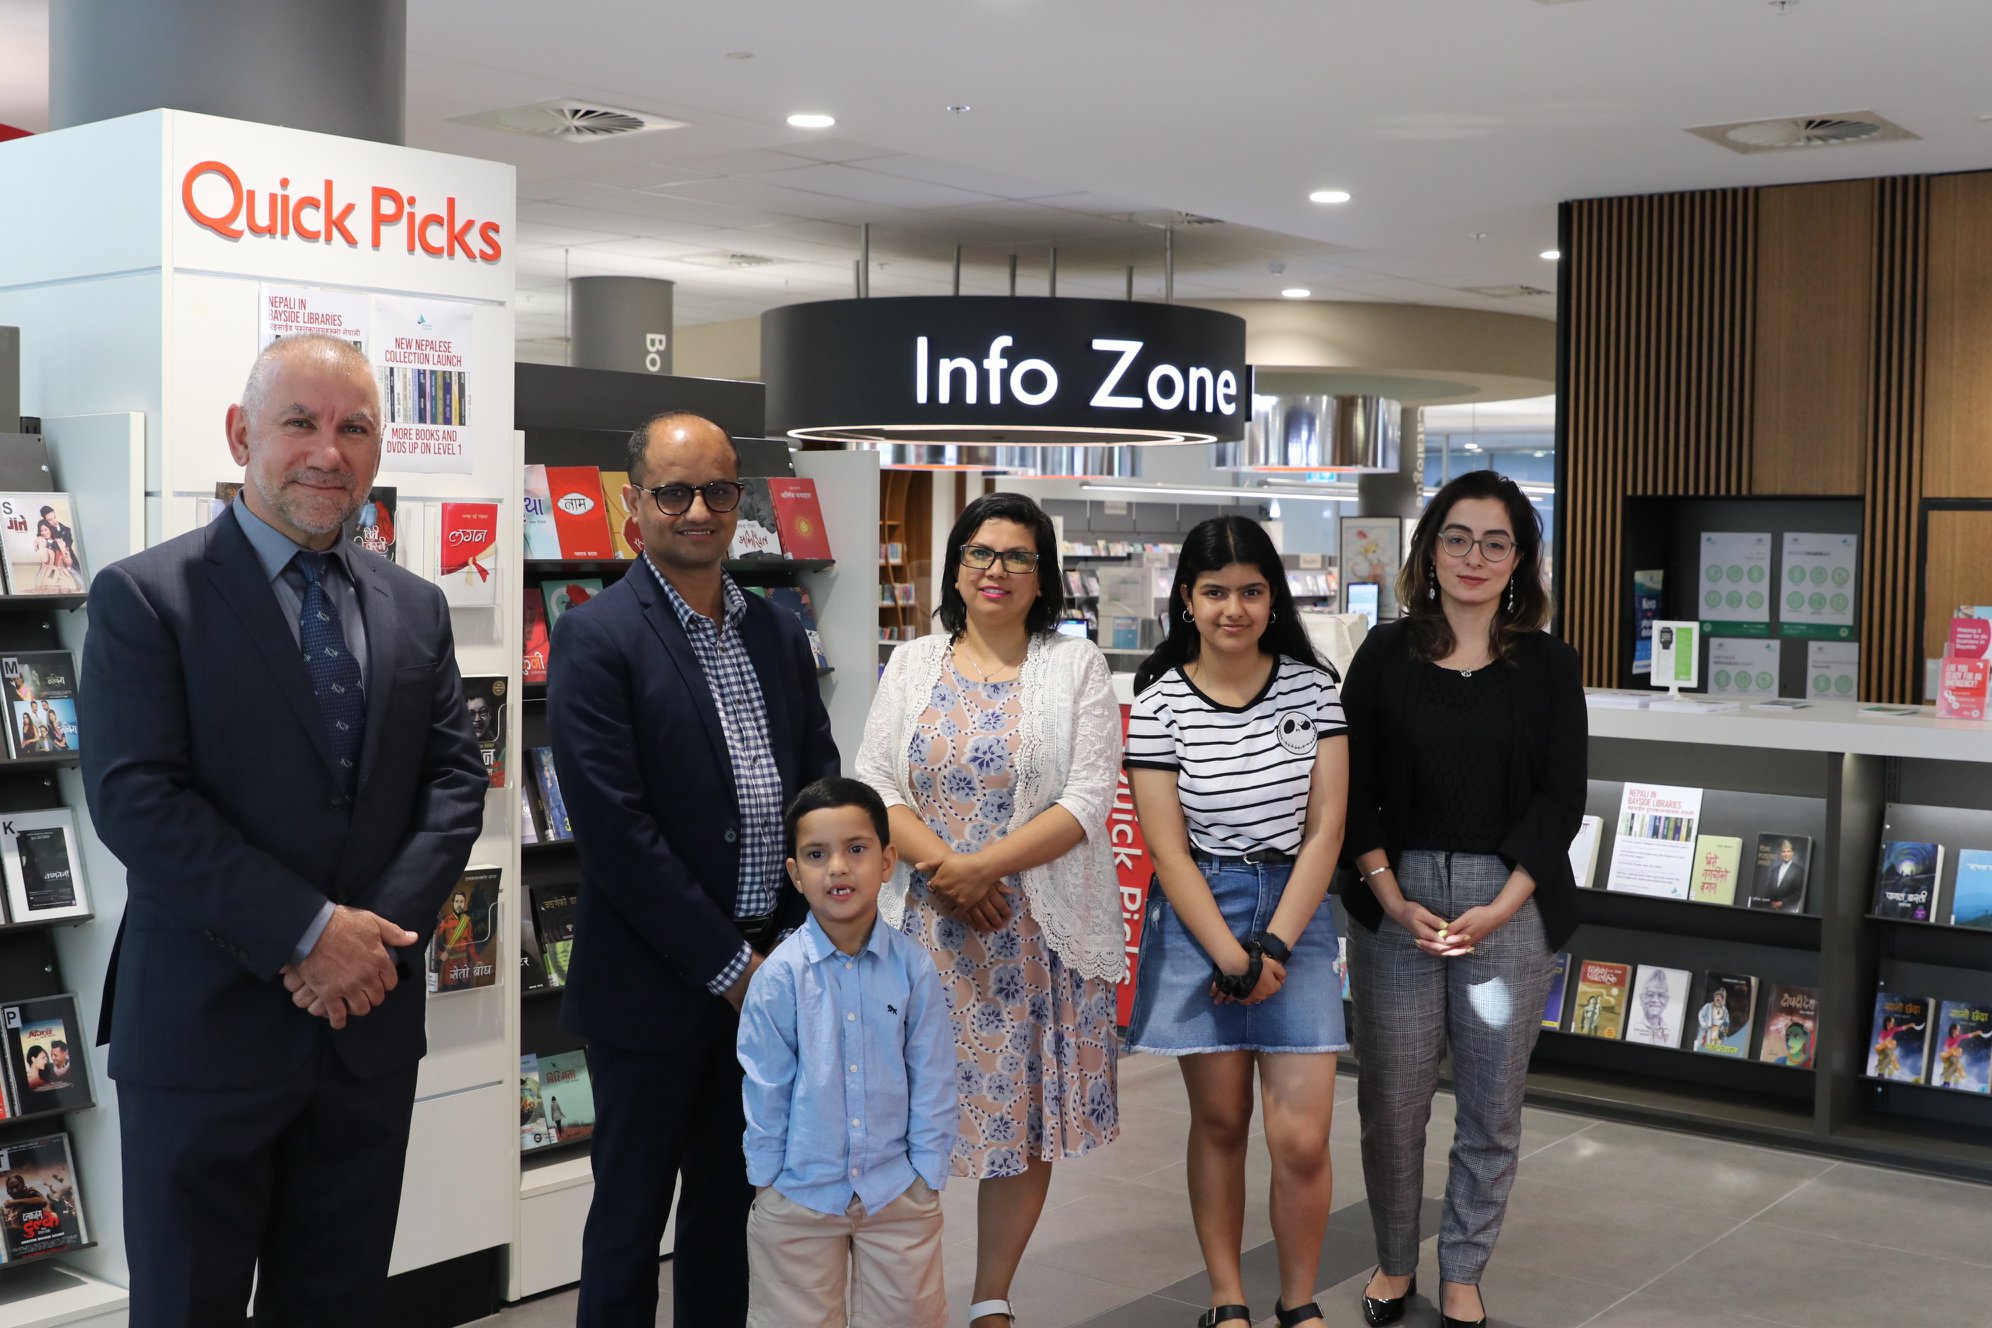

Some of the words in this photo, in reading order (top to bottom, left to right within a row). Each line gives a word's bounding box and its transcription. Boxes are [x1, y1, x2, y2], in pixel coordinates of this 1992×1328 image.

[182, 161, 358, 245] Quick
[371, 186, 502, 262] Picks
[269, 296, 296, 310] NEPALI
[298, 298, 307, 310] IN
[269, 309, 300, 324] BAYSIDE
[302, 313, 343, 327] LIBRARIES
[394, 337, 414, 350] NEW
[415, 338, 453, 354] NEPALESE
[384, 349, 430, 366] COLLECTION
[432, 353, 462, 368] LAUNCH
[916, 335, 1059, 406] Info
[1089, 338, 1238, 416] Zone
[391, 427, 413, 440] MORE
[415, 428, 440, 442] BOOKS
[442, 430, 458, 442] AND
[386, 441, 407, 454] DVDS
[408, 442, 419, 454] UP
[420, 442, 431, 455] ON
[433, 443, 456, 456] LEVEL
[1412, 406, 1425, 508] Catalogue
[2, 502, 13, 515] S
[563, 498, 586, 512] नाम
[448, 529, 488, 546] लगन
[4, 661, 19, 675] M
[1629, 789, 1649, 798] NEPALI
[1650, 790, 1657, 798] IN
[1627, 797, 1651, 806] BAYSIDE
[1652, 799, 1682, 809] LIBRARIES
[3, 820, 16, 835] K
[450, 964, 471, 981] सेतो
[6, 1011, 17, 1025] P
